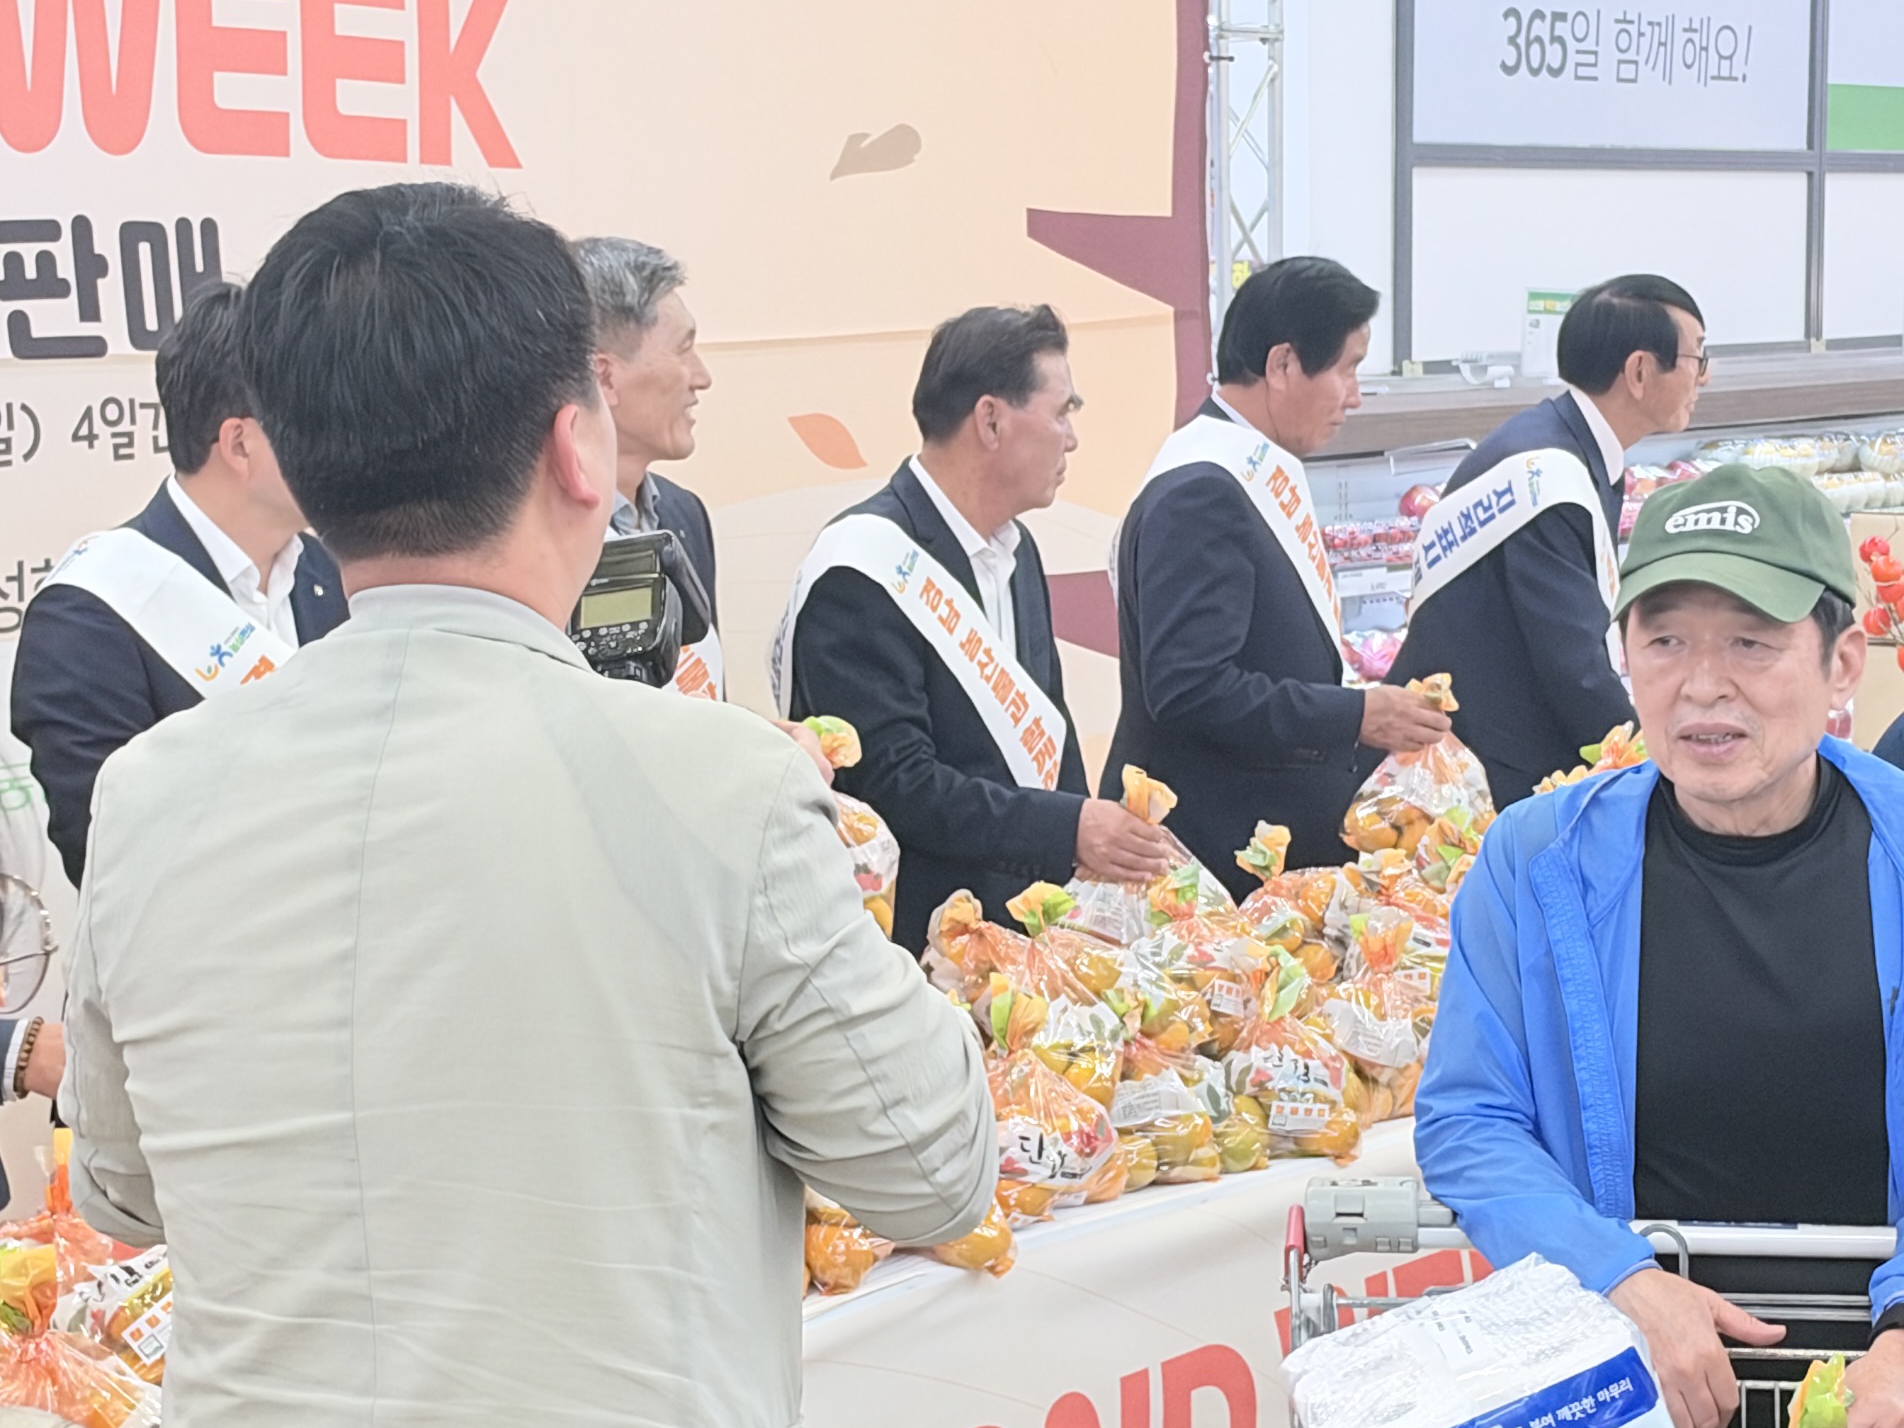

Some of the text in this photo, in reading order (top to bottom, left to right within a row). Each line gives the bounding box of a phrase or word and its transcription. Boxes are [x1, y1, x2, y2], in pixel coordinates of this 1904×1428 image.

[1498, 5, 1754, 87] 365일 함께 해요!
[1664, 502, 1760, 535] emis
[918, 576, 962, 637] 경남
[1555, 1397, 1596, 1423] 깨끗한
[1596, 1376, 1634, 1404] 마무리
